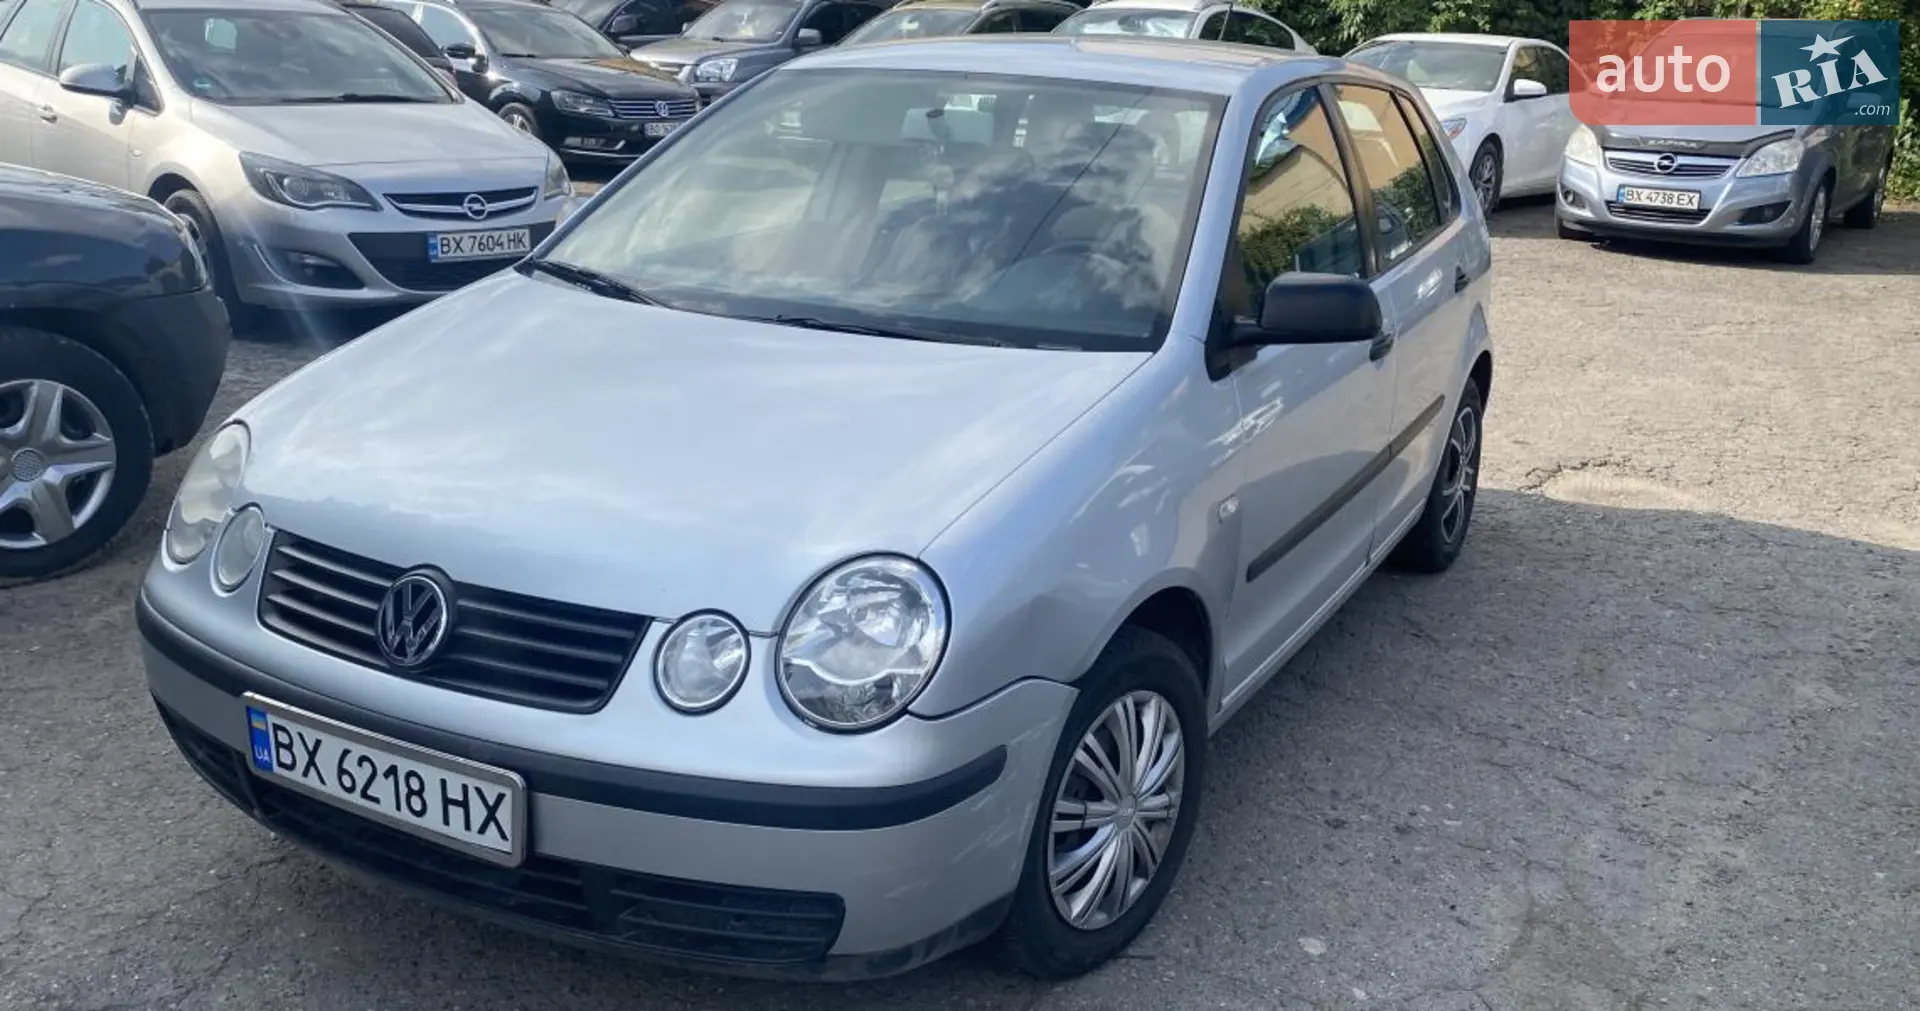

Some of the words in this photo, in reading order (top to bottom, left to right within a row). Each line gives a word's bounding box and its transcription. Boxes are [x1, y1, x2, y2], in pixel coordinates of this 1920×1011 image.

[1626, 189, 1643, 202] BX
[1646, 192, 1675, 205] 4738
[1677, 193, 1696, 206] EX
[440, 236, 464, 254] BX
[468, 234, 504, 252] 7604
[507, 231, 527, 249] HK
[254, 746, 270, 764] UA
[272, 722, 327, 786] BX
[337, 748, 428, 819] 6218
[439, 777, 510, 842] HX
